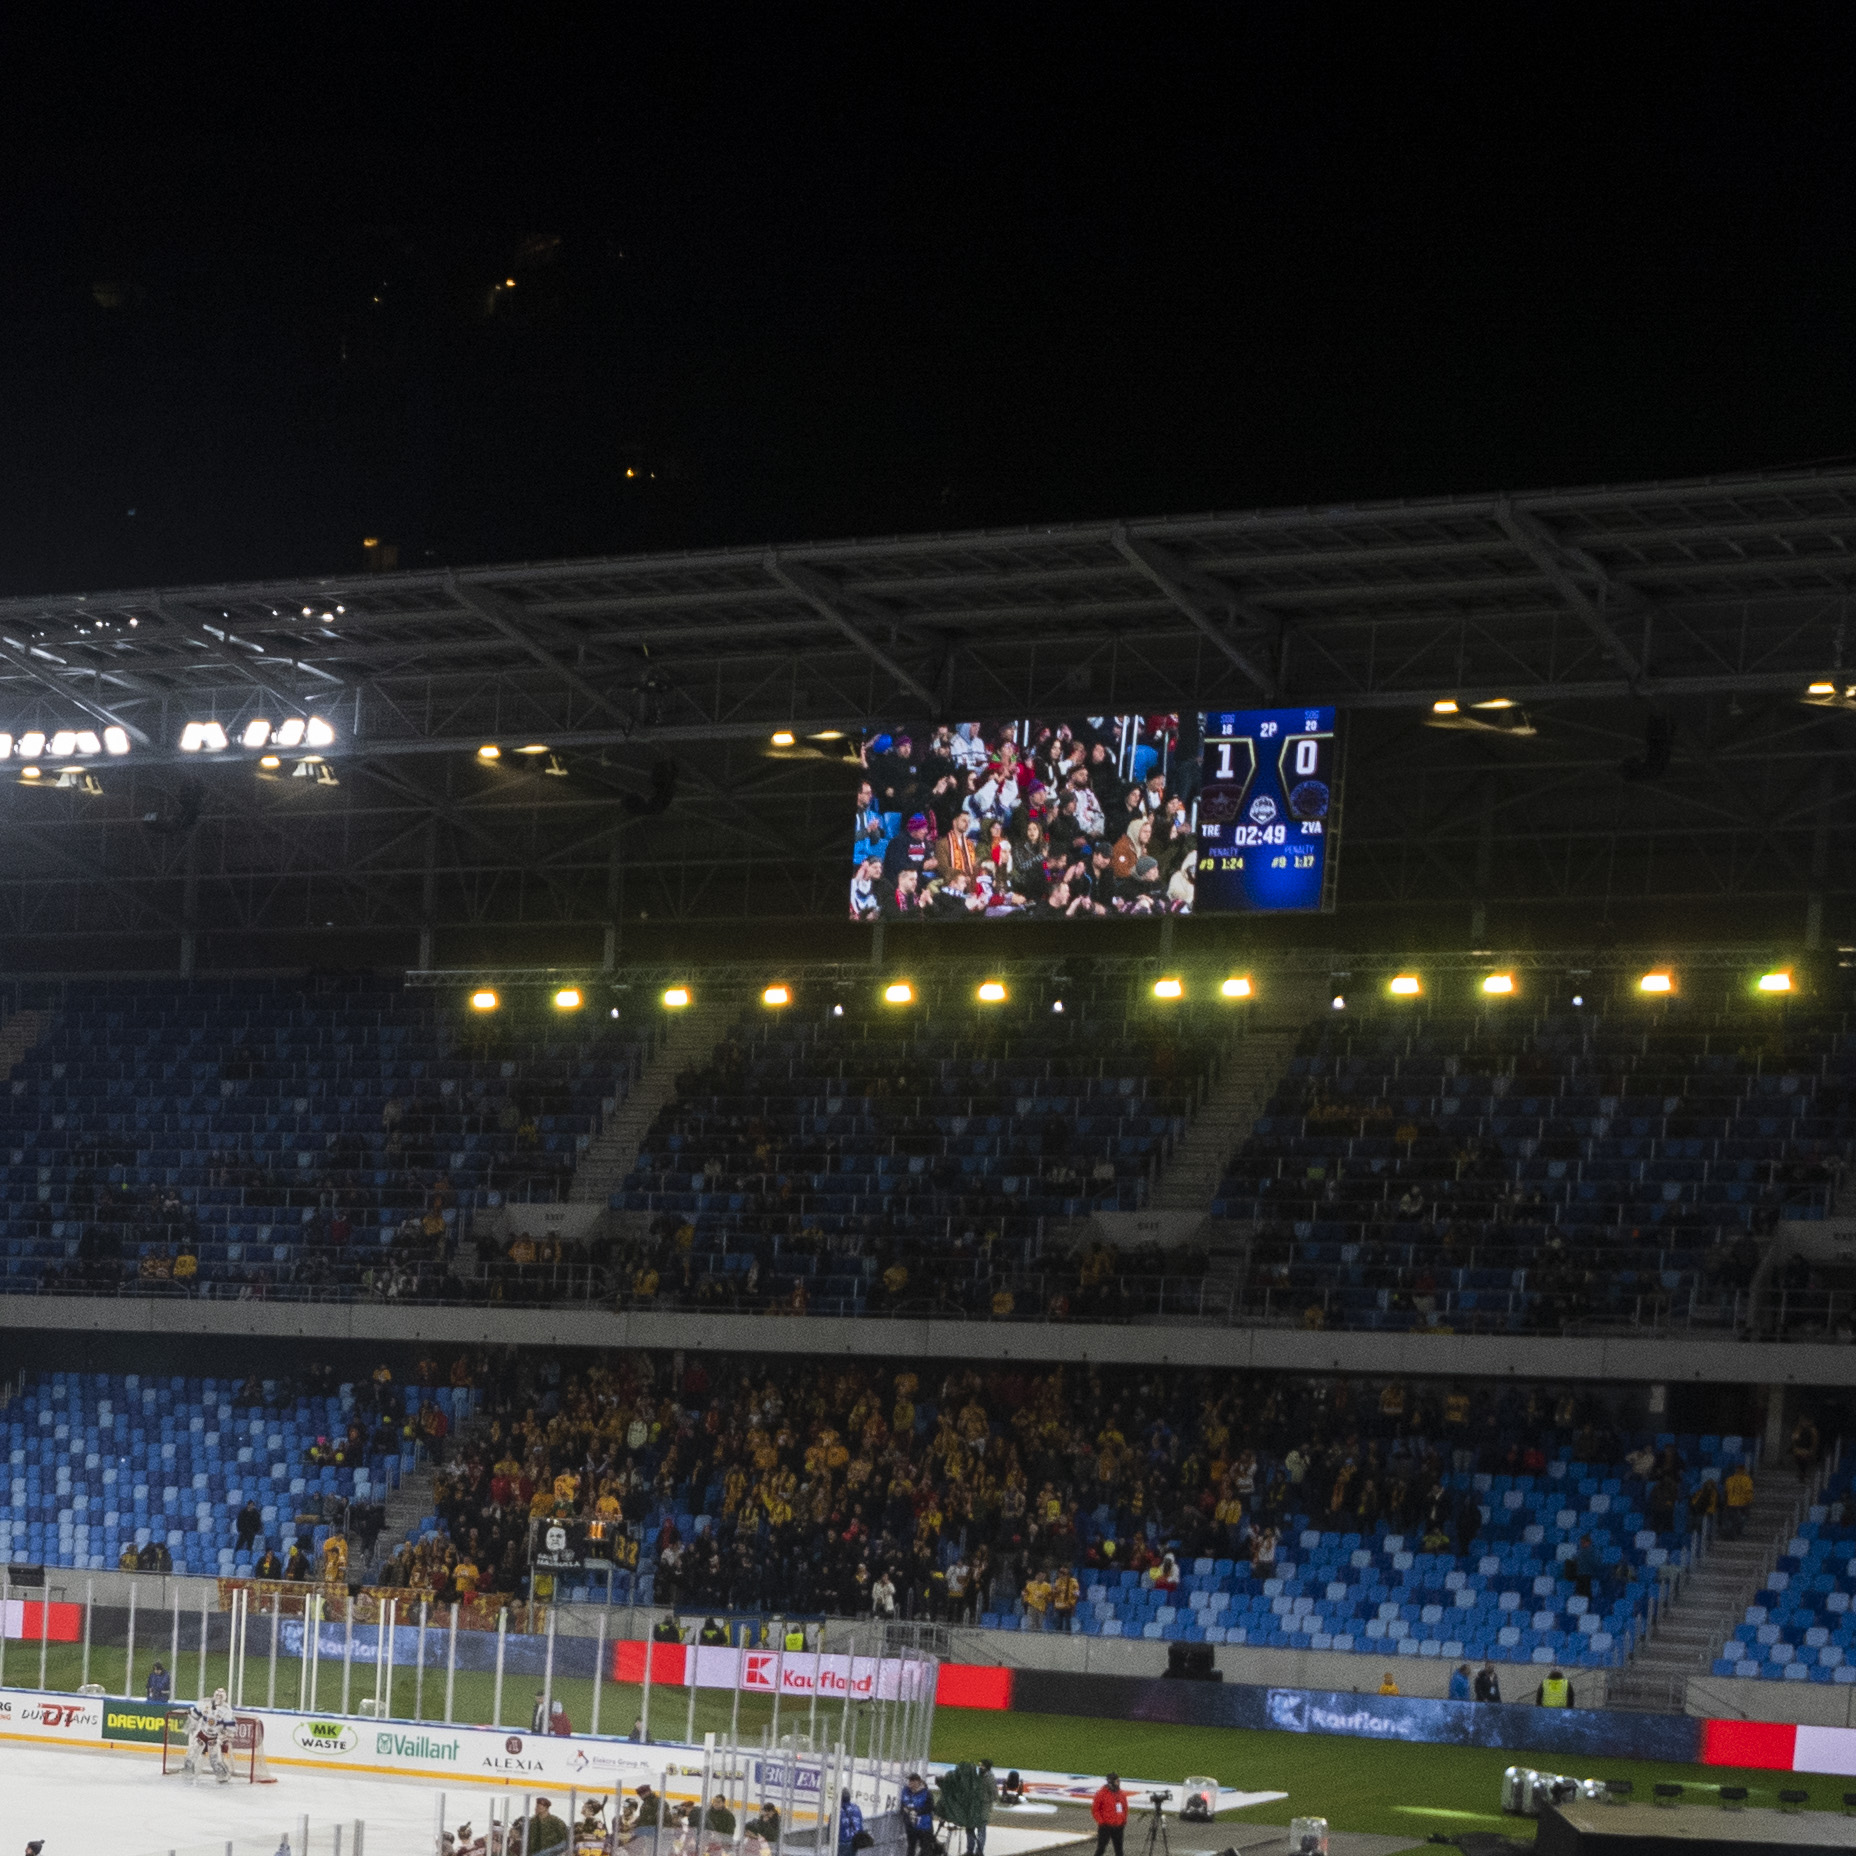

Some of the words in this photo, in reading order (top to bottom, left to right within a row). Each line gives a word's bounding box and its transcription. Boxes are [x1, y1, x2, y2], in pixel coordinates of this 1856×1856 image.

[1260, 722, 1278, 738] 2P
[1216, 744, 1234, 778] 1
[1296, 740, 1318, 775] 0
[1202, 825, 1221, 837] TRE
[1235, 825, 1286, 845] 02:49
[1301, 821, 1322, 834] ZVA
[1222, 858, 1244, 869] 1:24
[314, 1725, 337, 1736] MK
[302, 1737, 347, 1751] WASTE
[394, 1734, 459, 1761] Vaillant
[482, 1756, 544, 1772] ALEXIA
